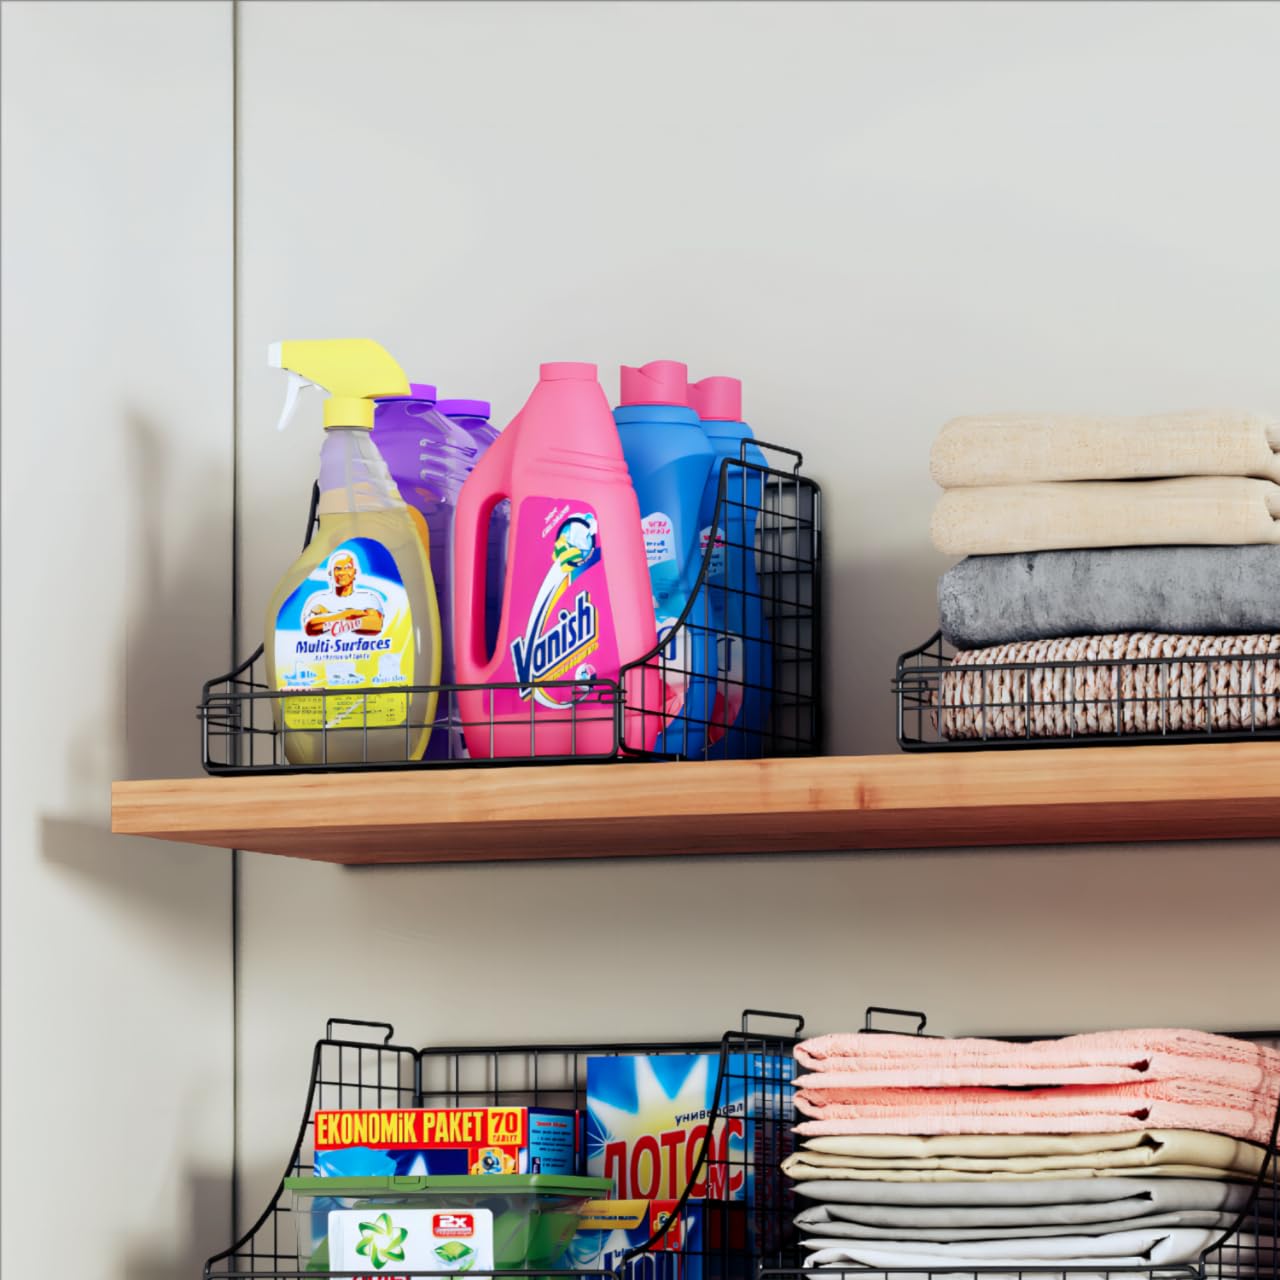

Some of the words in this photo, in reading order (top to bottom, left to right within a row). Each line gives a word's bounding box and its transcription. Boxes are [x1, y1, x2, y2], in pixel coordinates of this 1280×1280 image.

[511, 590, 597, 699] Vanish
[423, 1111, 483, 1143] PAKET
[491, 1111, 518, 1135] 70
[439, 1215, 468, 1228] 2x
